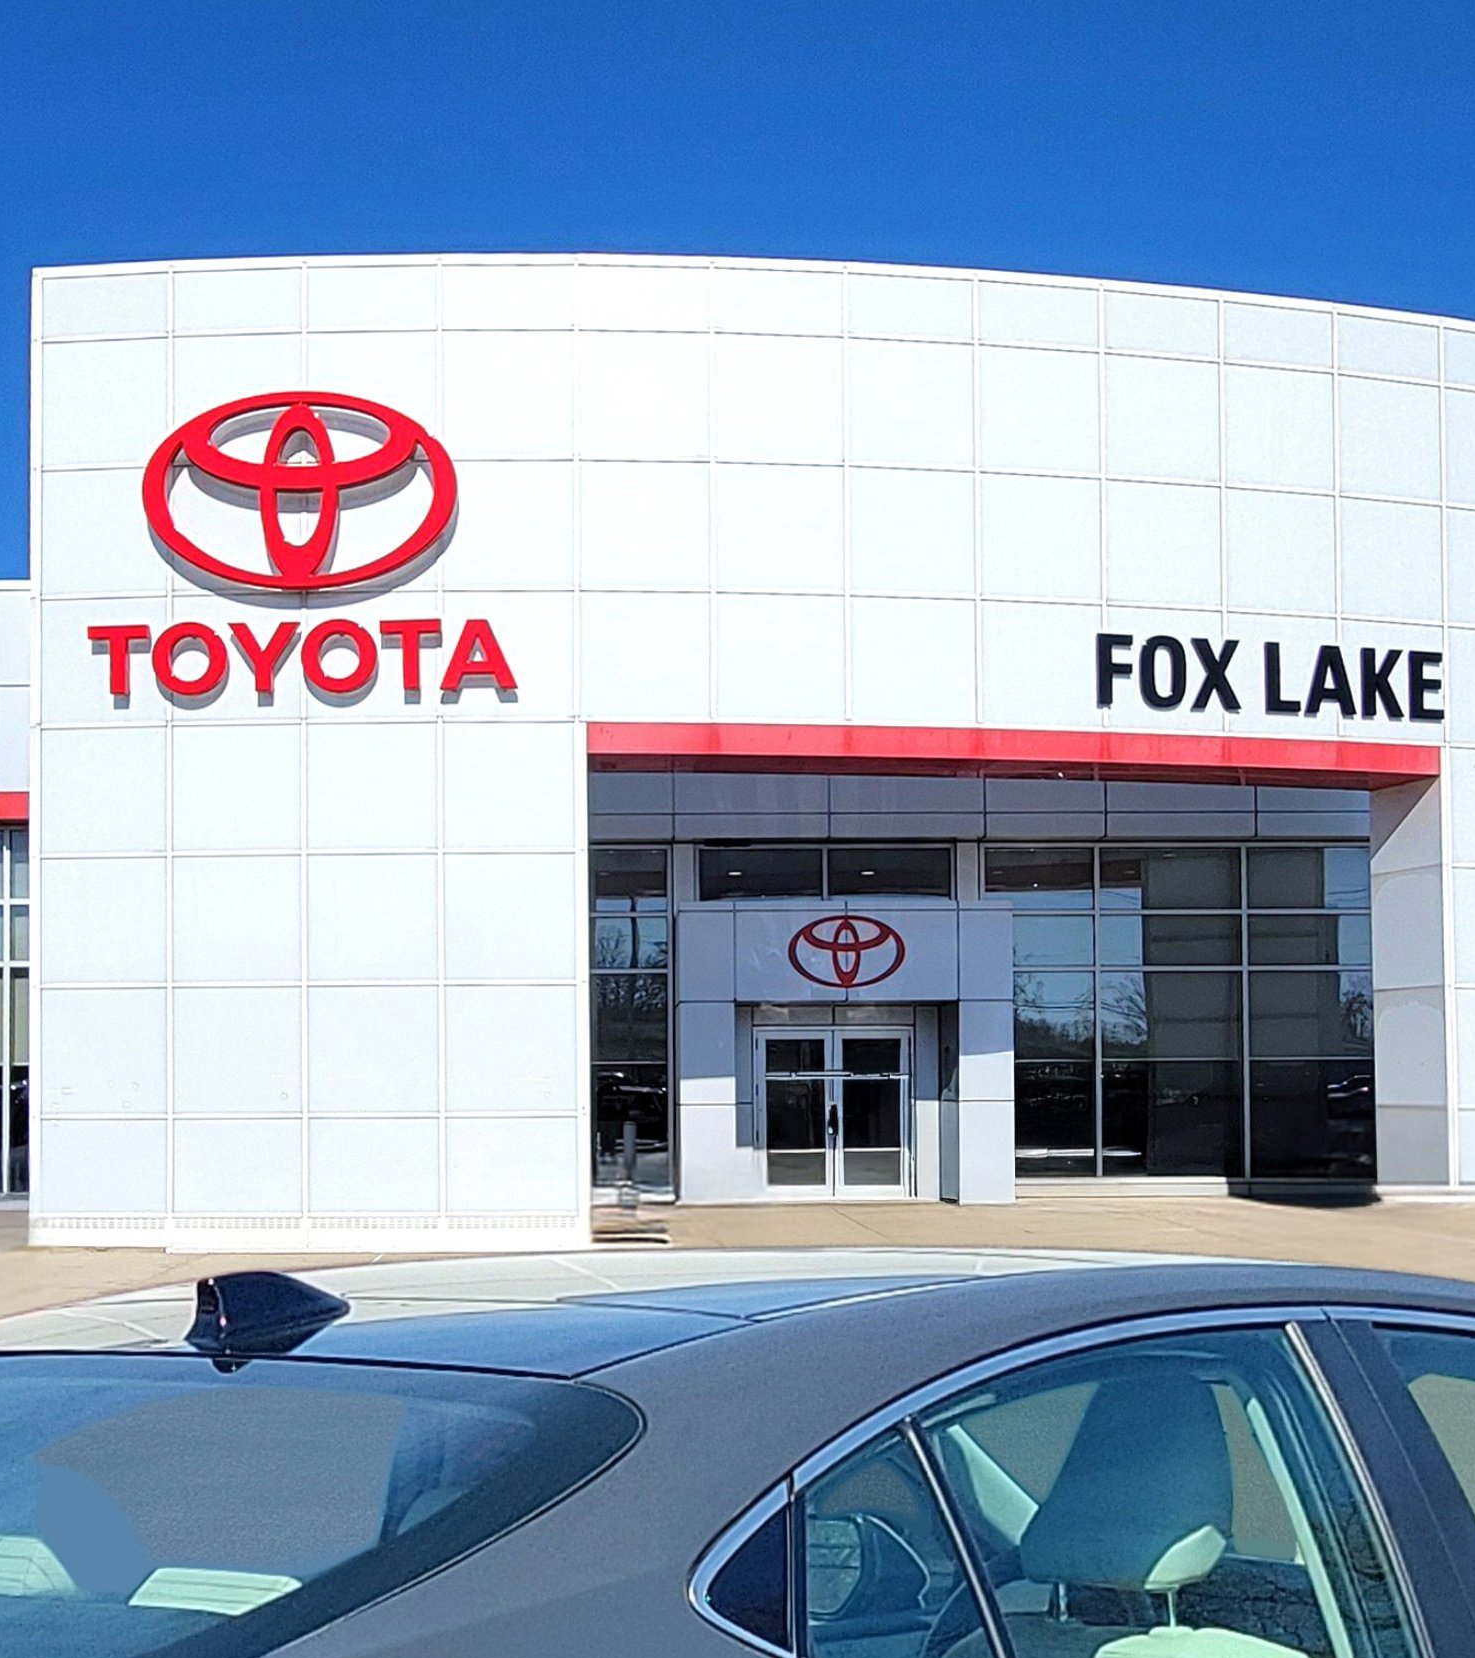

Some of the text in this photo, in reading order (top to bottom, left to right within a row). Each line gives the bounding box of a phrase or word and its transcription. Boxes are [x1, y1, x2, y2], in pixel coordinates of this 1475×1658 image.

[87, 618, 518, 703] TOYOTA
[1096, 633, 1446, 721] FOX LAKE
